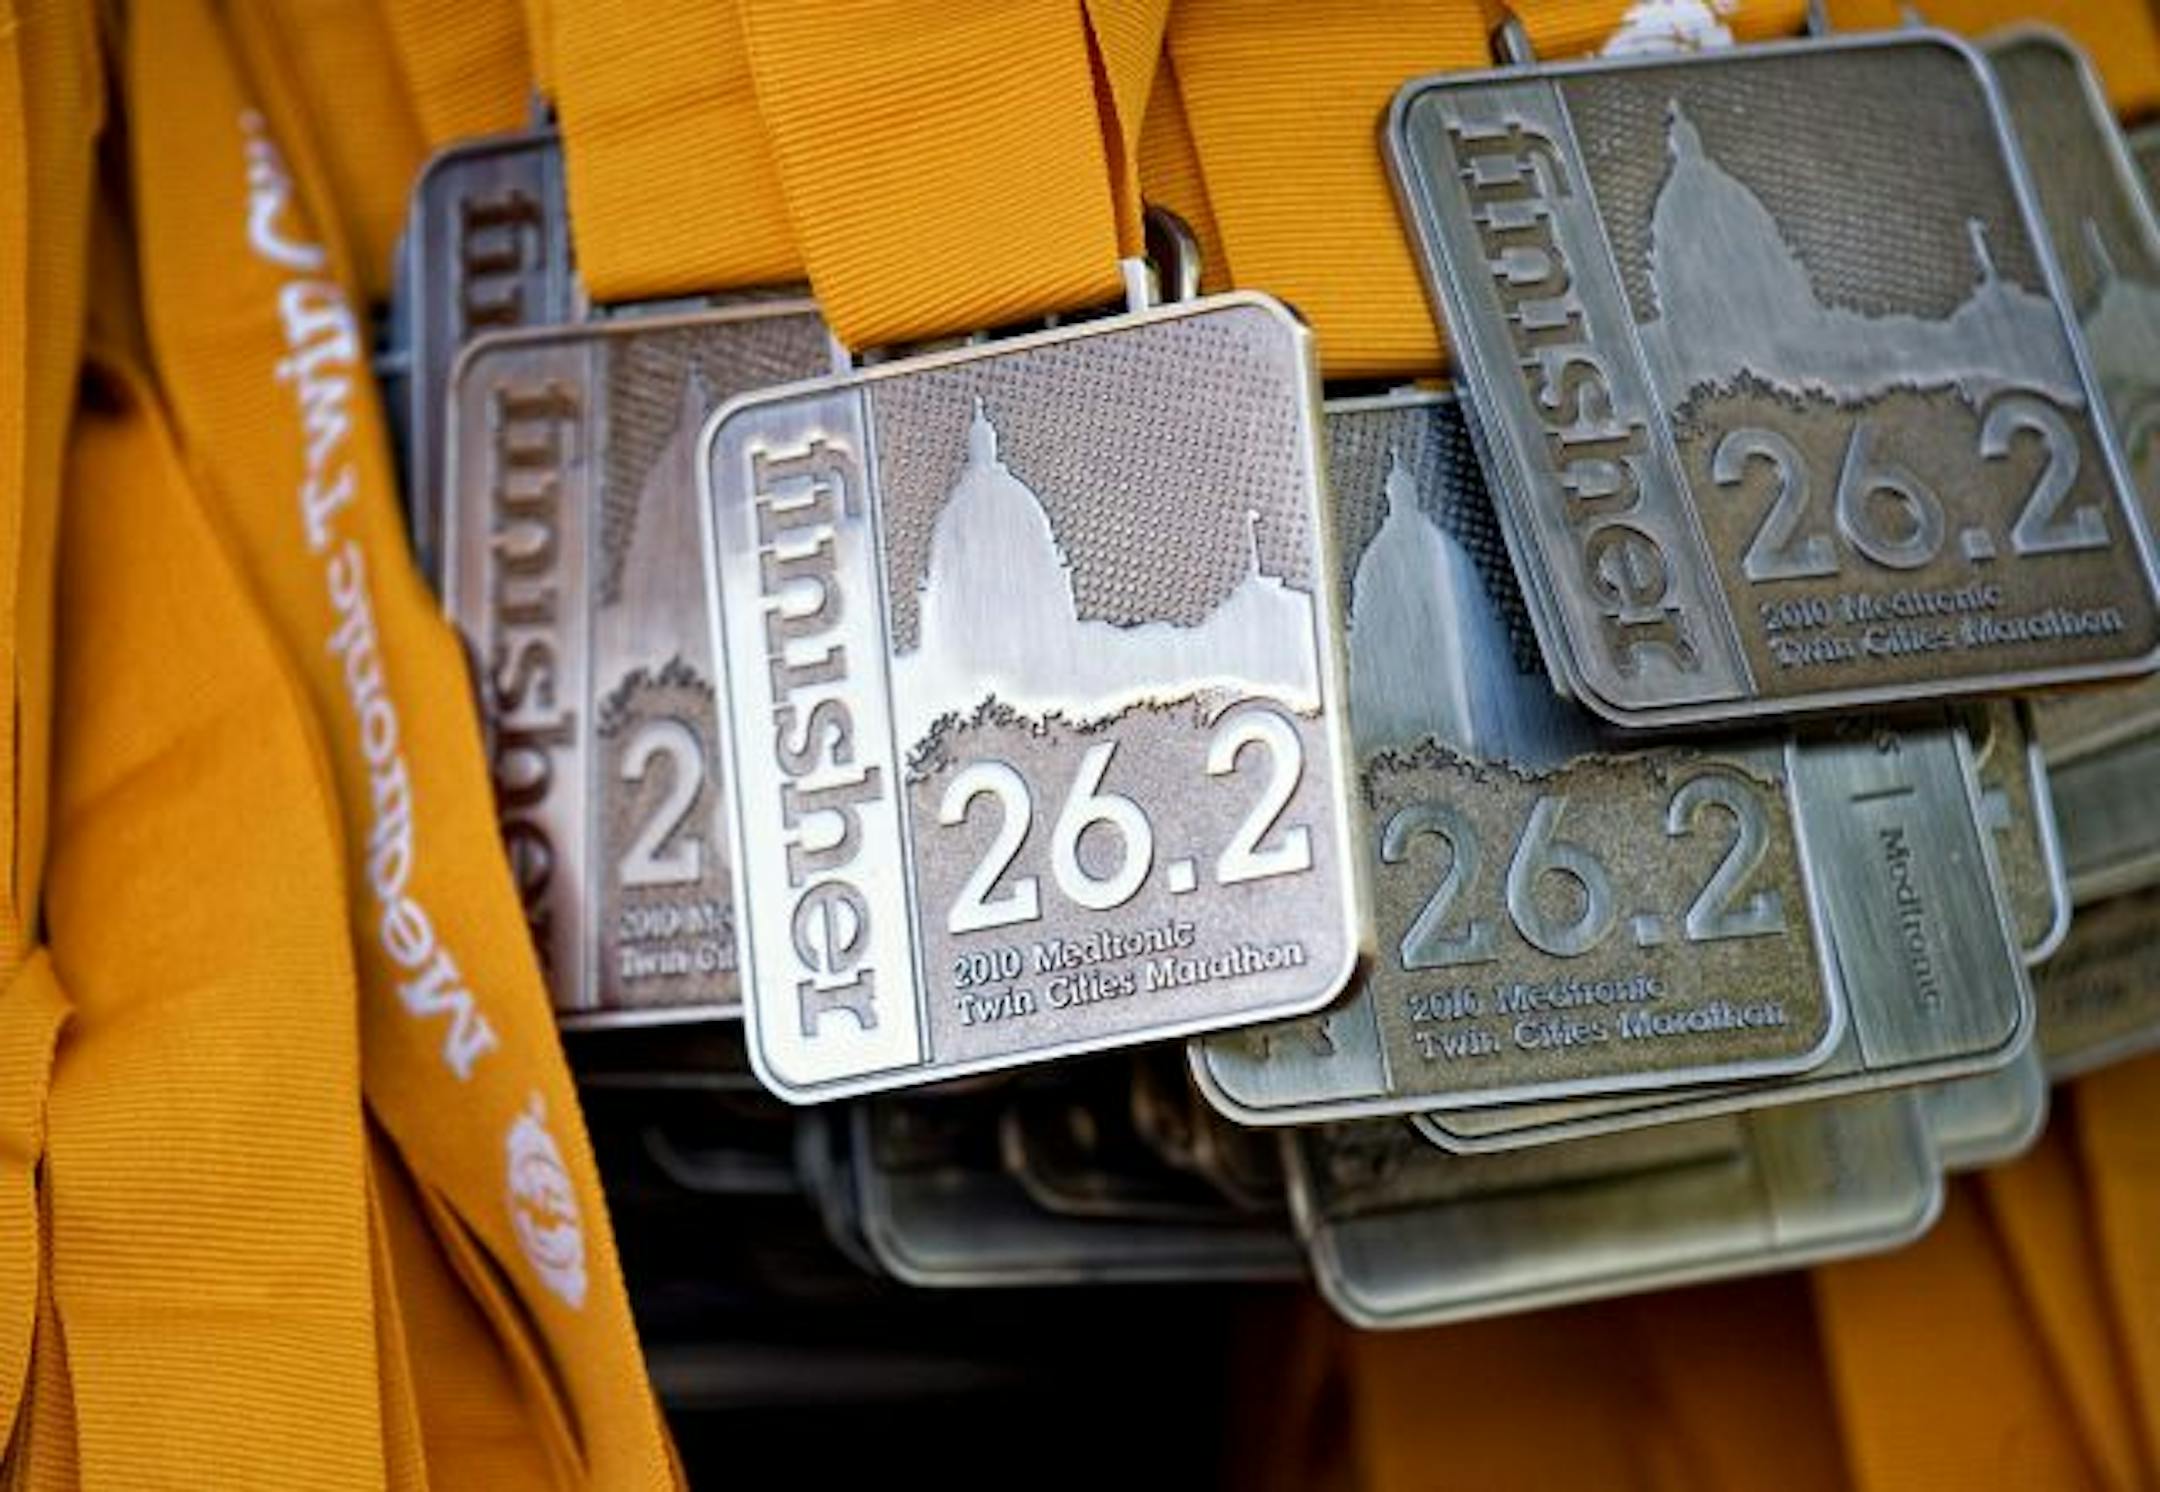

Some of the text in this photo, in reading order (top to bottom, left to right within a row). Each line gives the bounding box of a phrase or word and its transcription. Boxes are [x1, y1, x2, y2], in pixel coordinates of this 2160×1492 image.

[276, 280, 359, 551] Twin
[1445, 114, 1699, 679] finisher
[1712, 400, 2111, 584] 26.2
[1840, 583, 2002, 624] Medtronic
[1958, 605, 2125, 649] Marathon
[327, 540, 500, 1081] Medtronic
[747, 430, 885, 1037] finisher
[938, 706, 1314, 936] 26.2
[952, 918, 1197, 990] 2010 Medtronic
[1380, 780, 1786, 972] 26.2
[1878, 826, 1943, 1013] Medtronic
[956, 939, 1307, 1027] Twin Cities Marathon
[1414, 999, 1786, 1063] Twin Cities Marathon
[1495, 974, 1665, 1016] Medtronic
